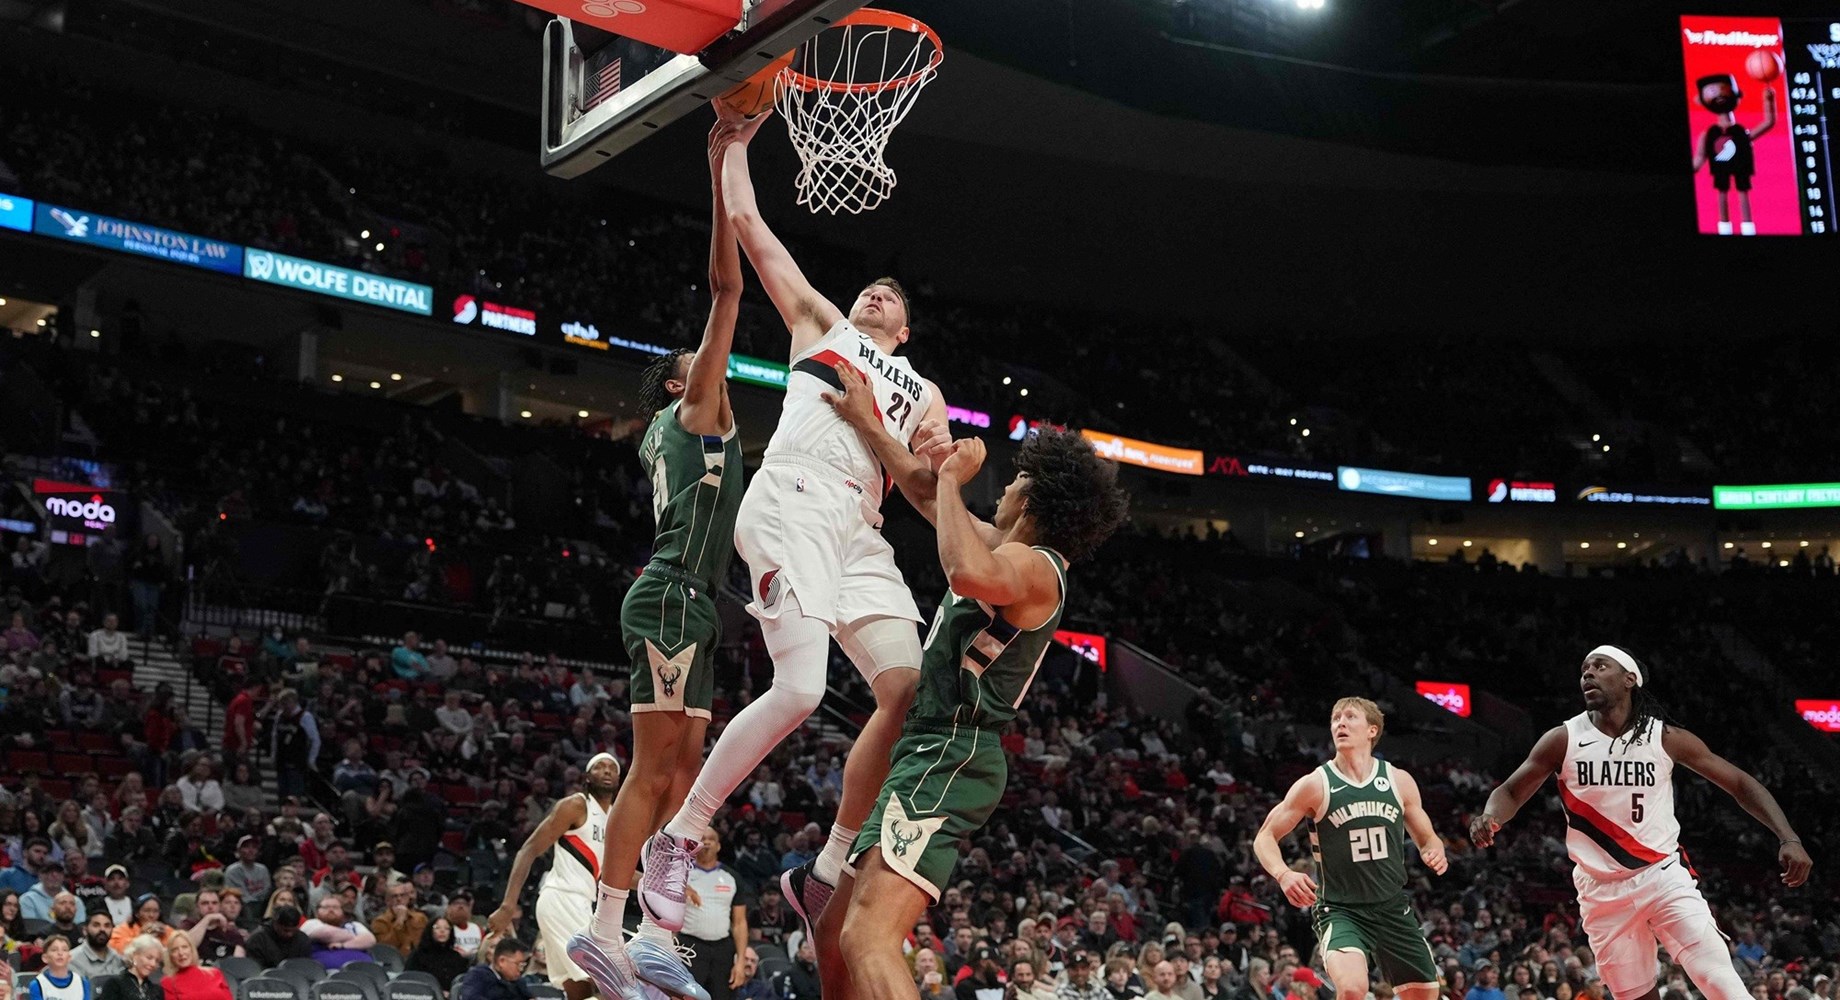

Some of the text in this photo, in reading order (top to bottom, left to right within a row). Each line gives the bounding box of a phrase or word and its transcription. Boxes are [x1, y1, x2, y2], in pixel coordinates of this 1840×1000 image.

[96, 218, 230, 259] JOHNSTON LAW
[275, 258, 429, 311] WOLFE DENTAL
[481, 310, 536, 336] PARTNERS
[858, 340, 923, 402] BLAZERS
[1510, 487, 1556, 502] PARTNERS
[1754, 490, 1804, 504] CENTURY
[45, 498, 116, 523] moda
[1576, 761, 1656, 787] BLAZERS
[1328, 801, 1400, 829] MILWAUKEE
[1631, 793, 1644, 824] 5
[1349, 826, 1389, 863] 20
